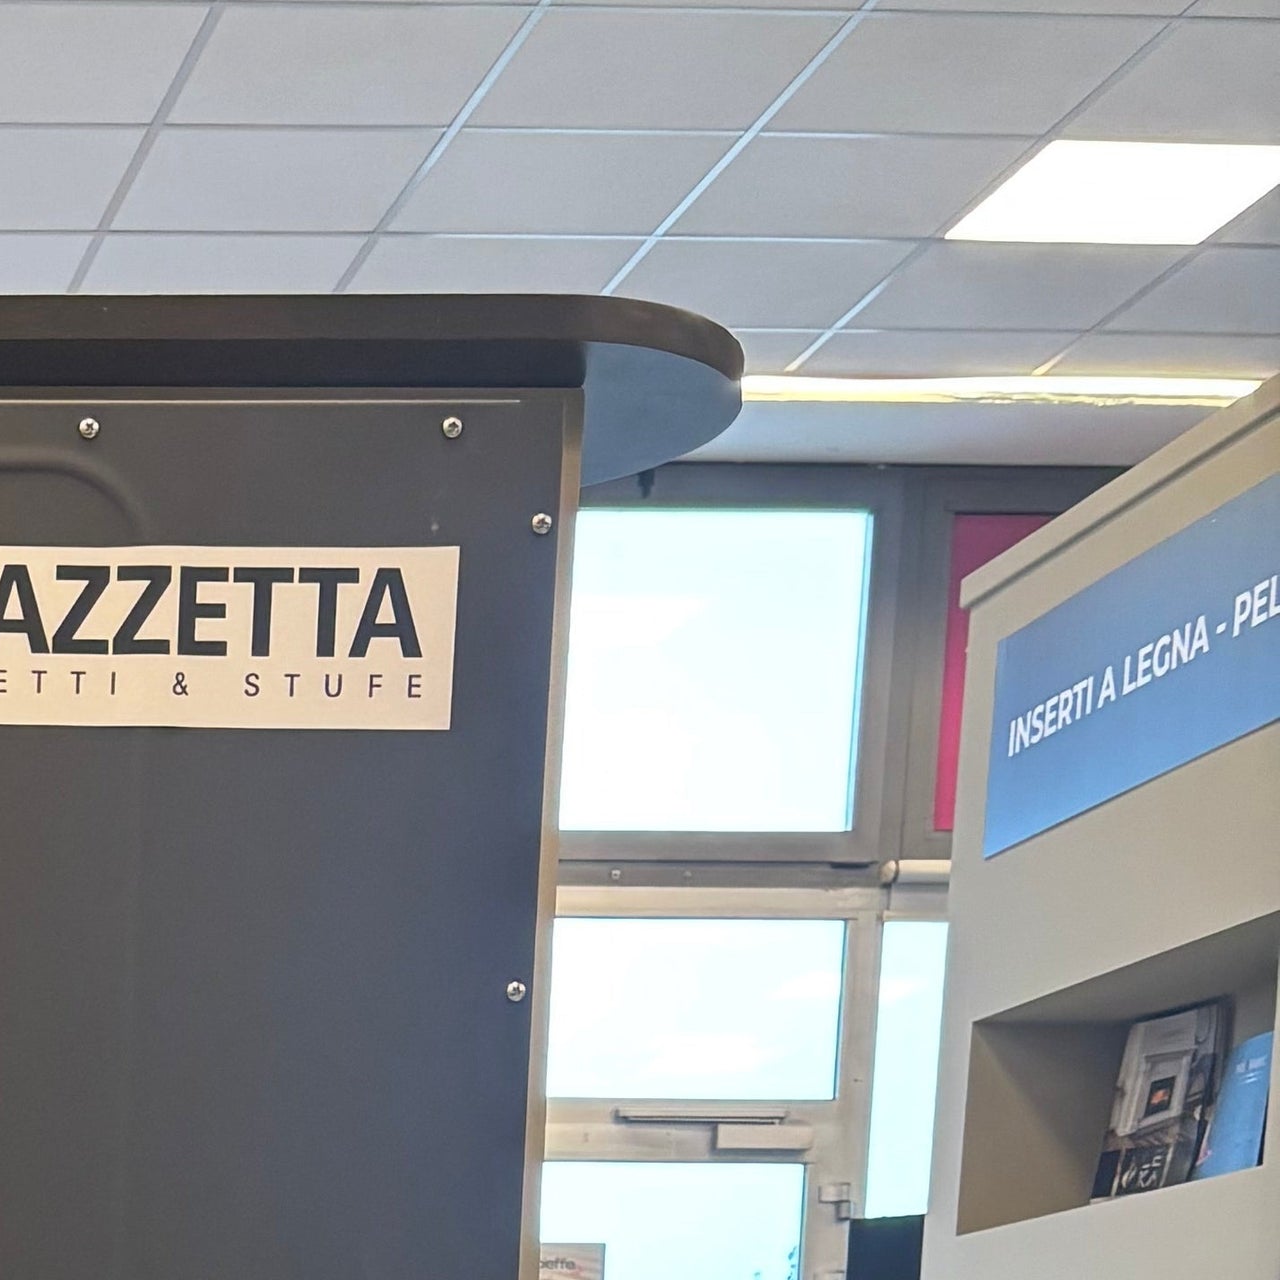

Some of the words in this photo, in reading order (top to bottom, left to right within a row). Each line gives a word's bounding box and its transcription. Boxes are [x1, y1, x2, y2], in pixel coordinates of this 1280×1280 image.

[172, 671, 189, 697] &
[244, 672, 423, 699] STUFE
[1007, 676, 1095, 758] INSERTI
[1097, 665, 1117, 709] A
[1122, 615, 1210, 696] LEGNA
[1232, 574, 1280, 638] PEL
